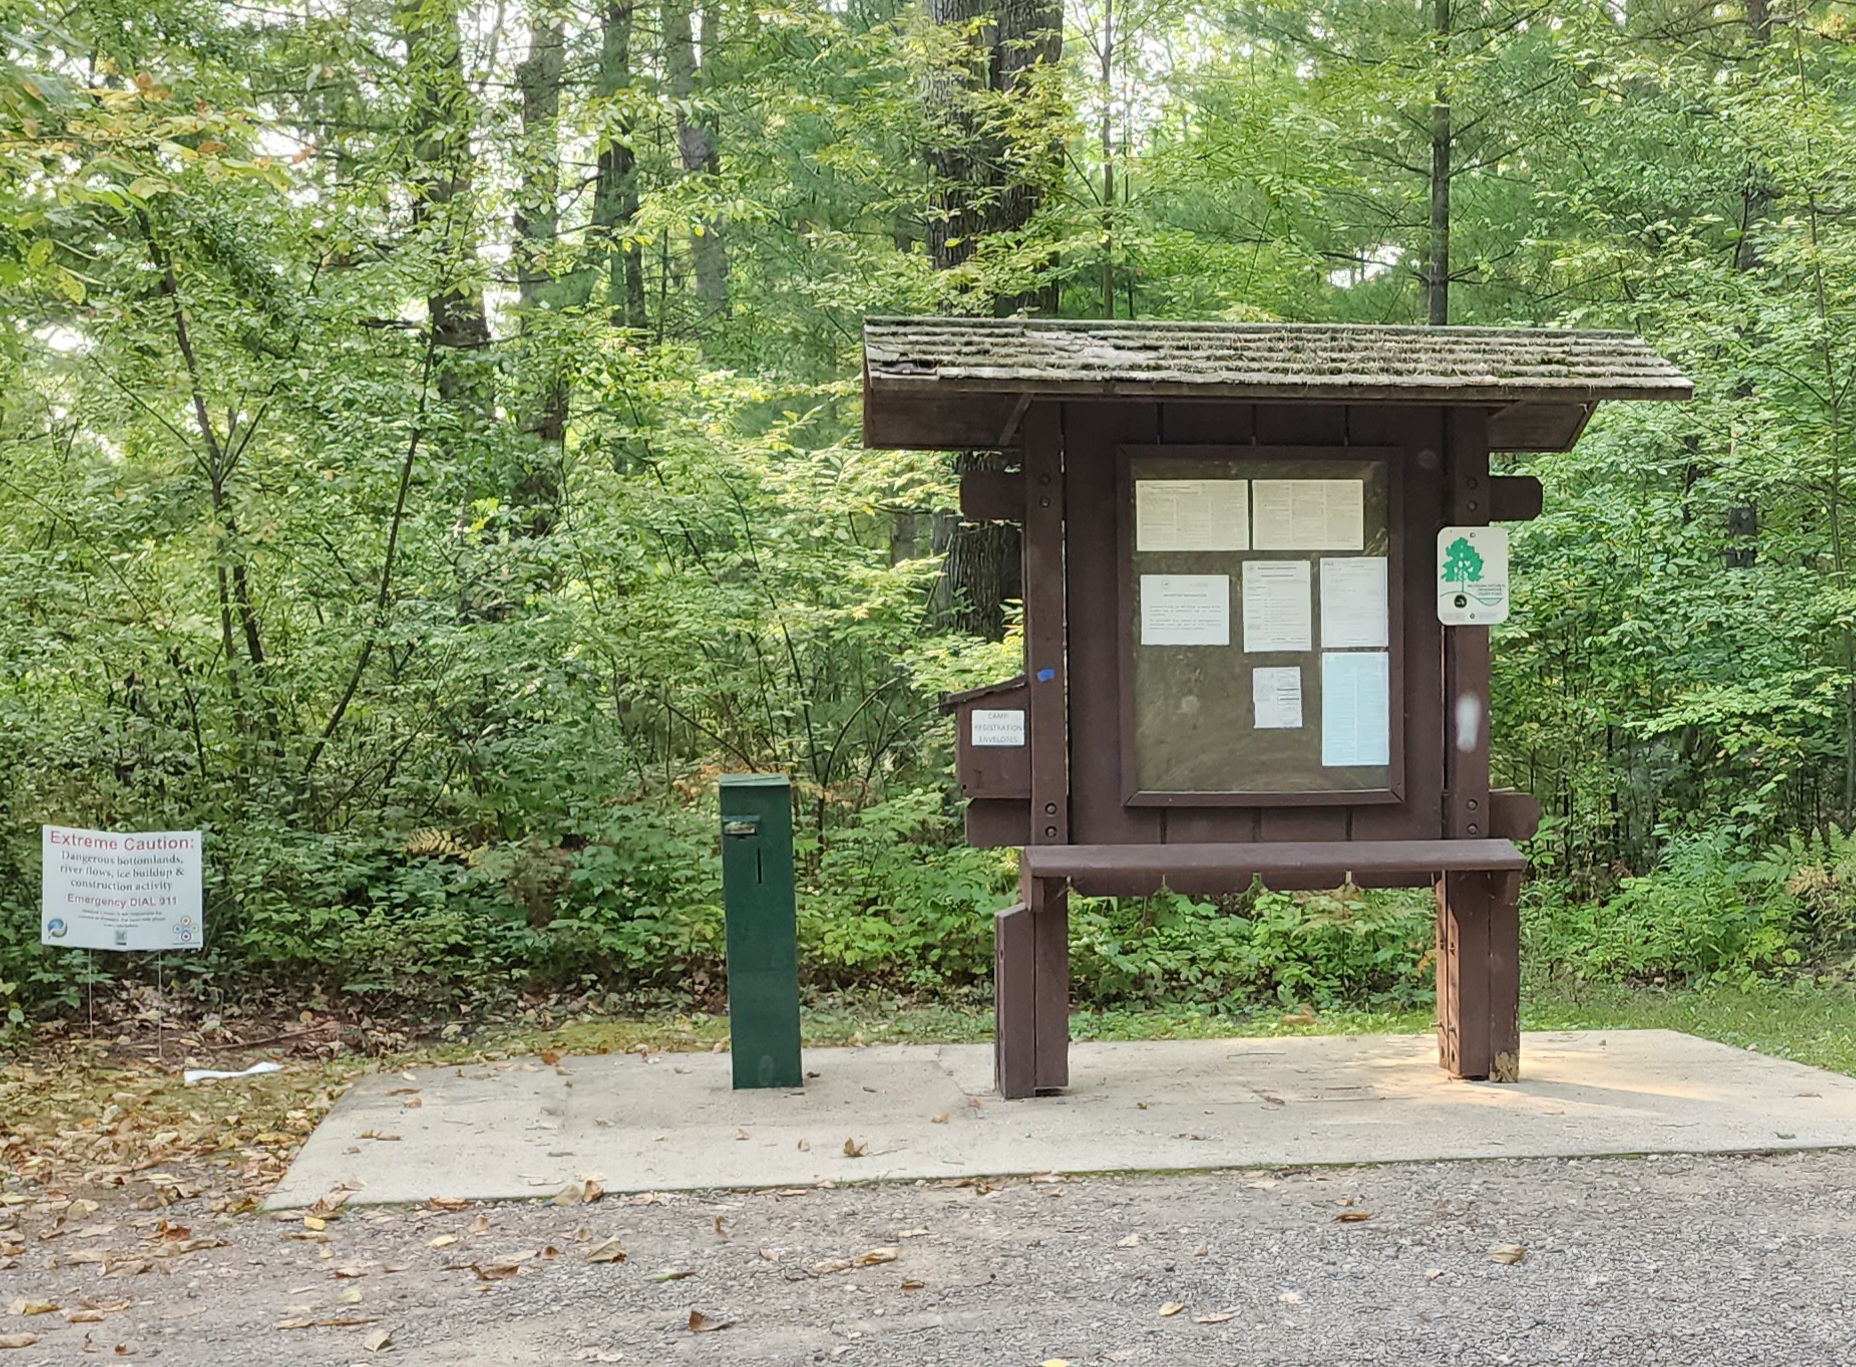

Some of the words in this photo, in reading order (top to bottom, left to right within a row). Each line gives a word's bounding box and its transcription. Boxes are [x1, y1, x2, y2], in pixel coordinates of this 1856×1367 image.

[50, 830, 118, 850] Extreme
[124, 836, 194, 851] Caution:
[61, 850, 115, 864] Dangerous
[117, 854, 183, 866] bottomlands,
[60, 866, 82, 875] river
[85, 866, 114, 878] flows,
[116, 869, 131, 878] ice
[132, 868, 173, 879] buildup
[175, 868, 184, 876] &
[70, 880, 133, 891] construction
[135, 881, 173, 892] activity
[67, 894, 127, 909] Emergency
[130, 897, 156, 907] DIAL
[159, 896, 177, 906] 911
